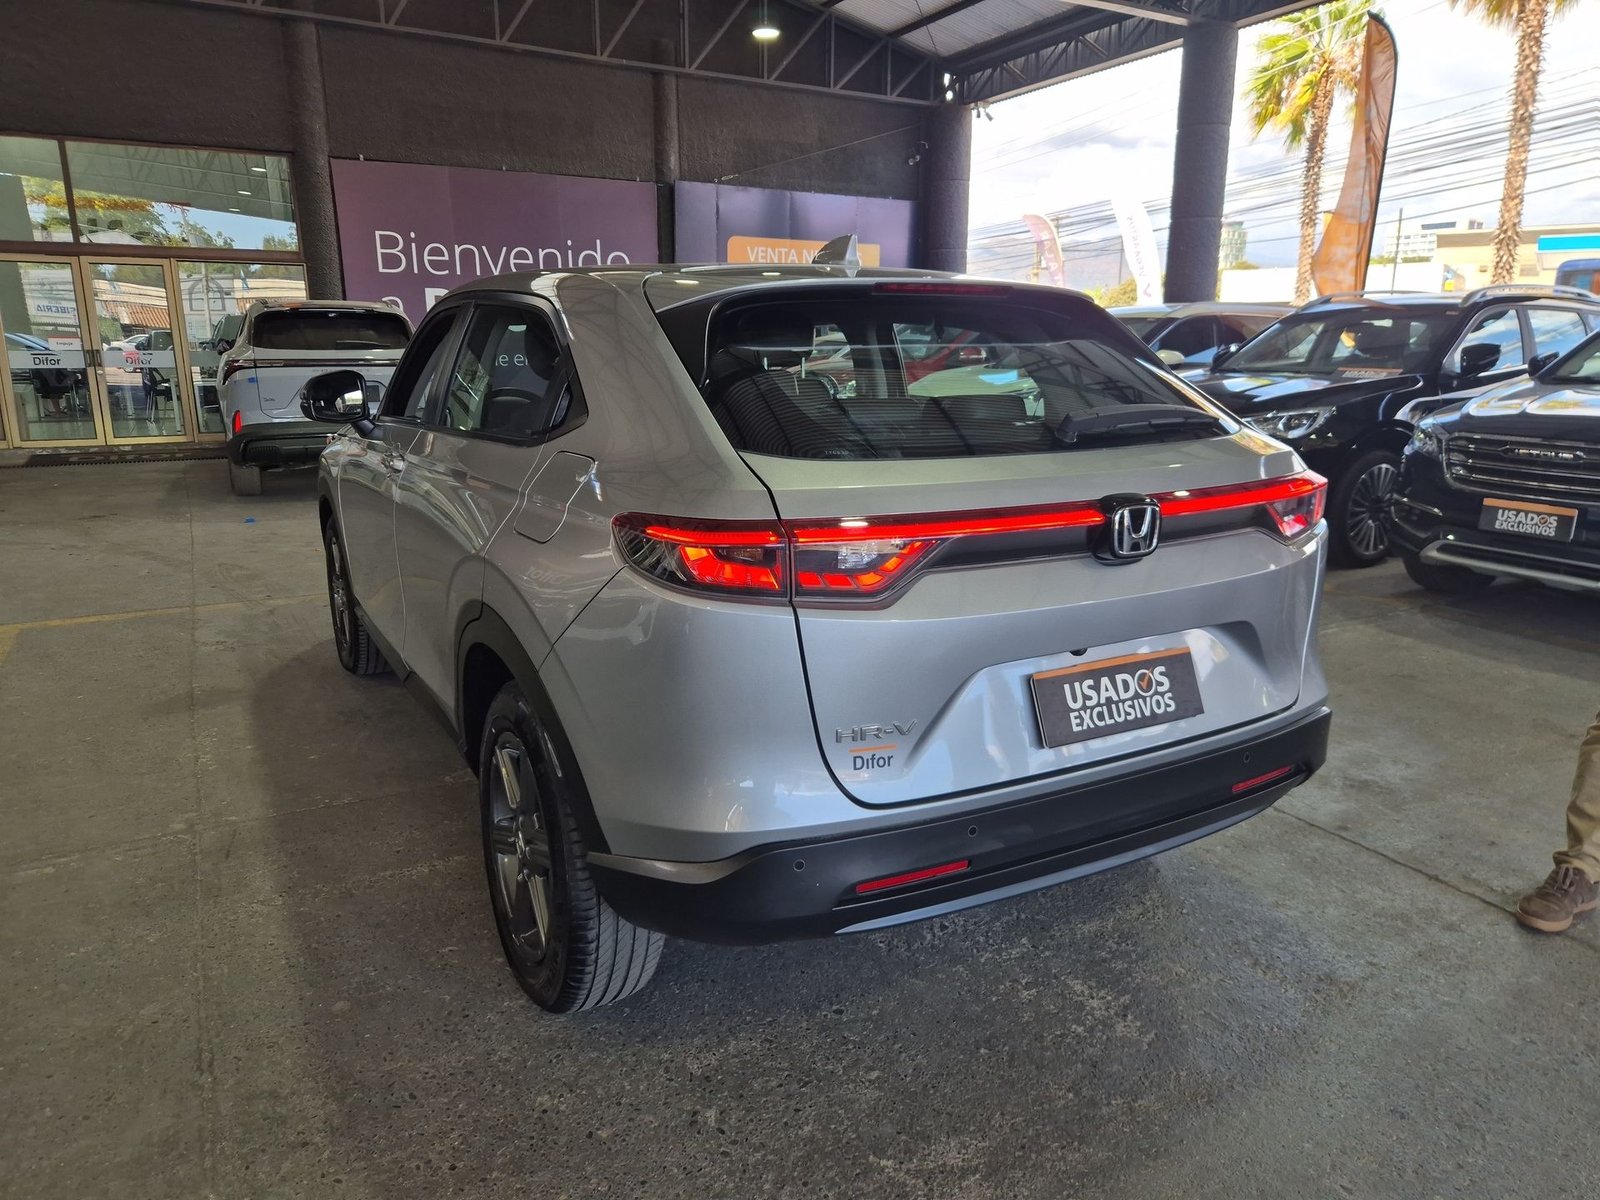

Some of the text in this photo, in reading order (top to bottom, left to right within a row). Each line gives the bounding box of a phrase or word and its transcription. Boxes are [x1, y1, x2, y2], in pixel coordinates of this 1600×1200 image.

[746, 245, 799, 263] VENTA
[32, 356, 61, 366] Difor
[125, 356, 152, 365] Difor
[1497, 509, 1558, 528] USADOS
[1494, 519, 1556, 537] EXCLUSIVOS
[1063, 665, 1170, 710] USADOS
[1069, 692, 1176, 732] EXCLUSIVOS
[835, 719, 917, 743] HR-V
